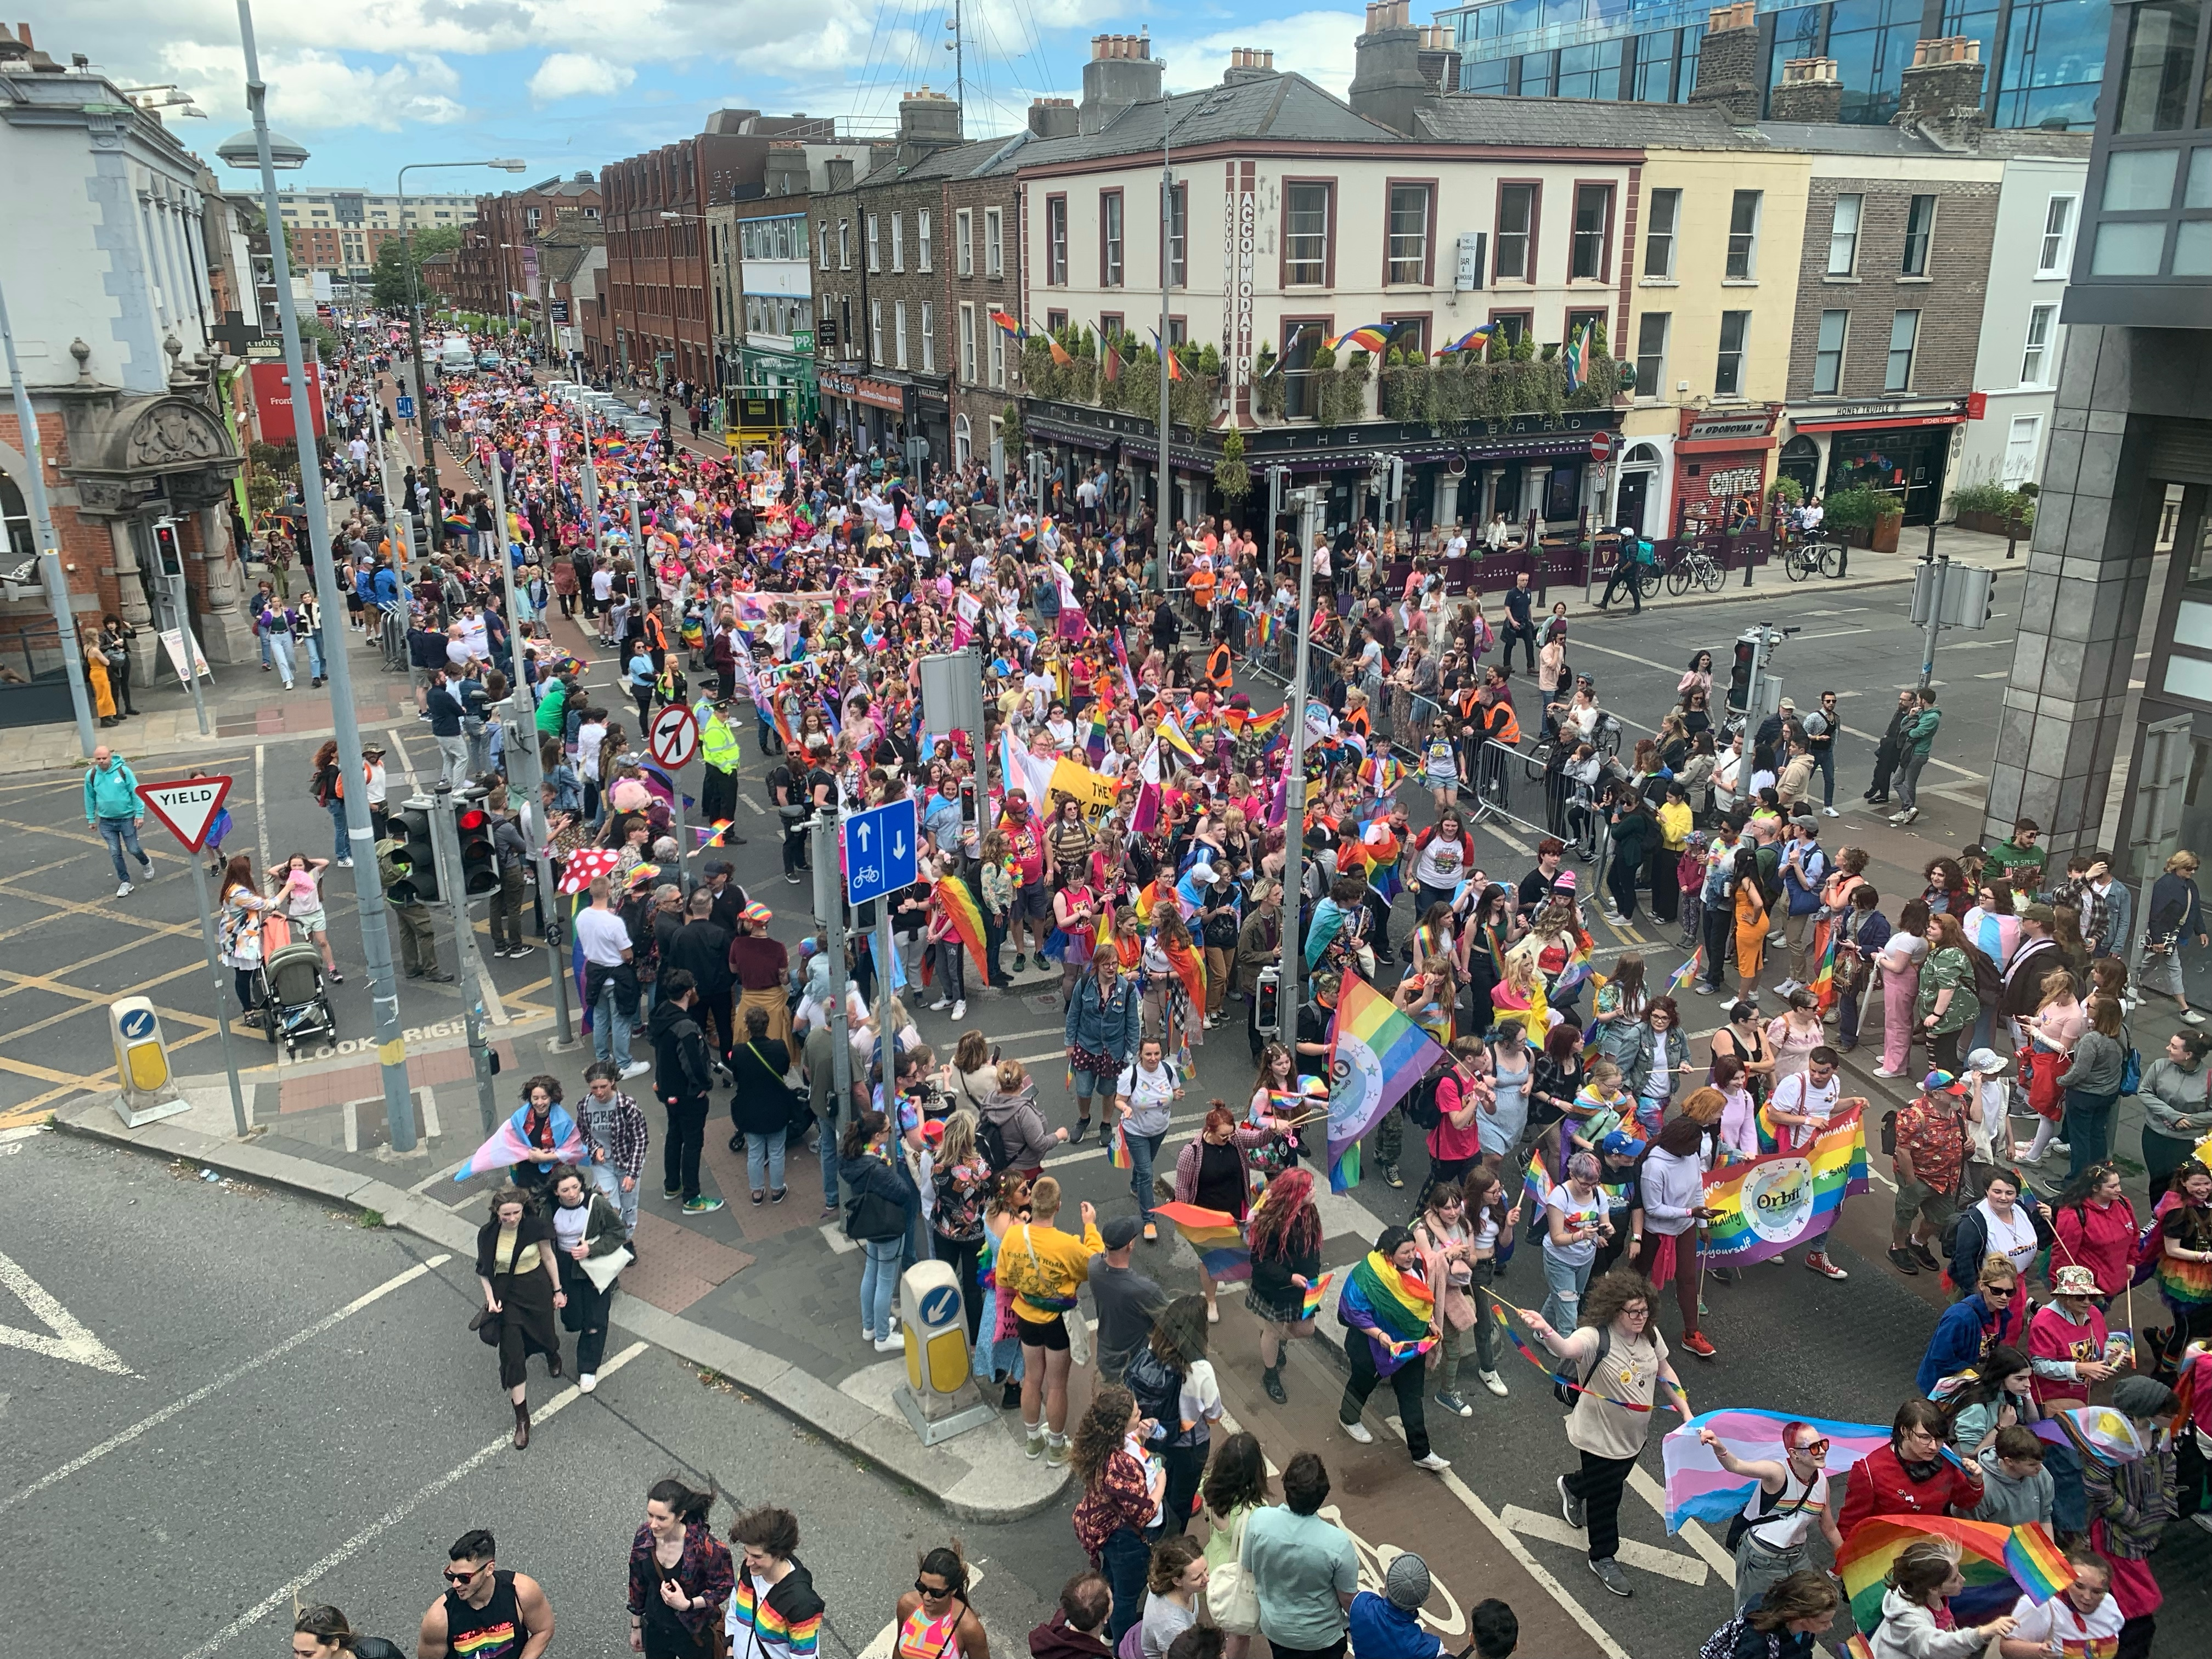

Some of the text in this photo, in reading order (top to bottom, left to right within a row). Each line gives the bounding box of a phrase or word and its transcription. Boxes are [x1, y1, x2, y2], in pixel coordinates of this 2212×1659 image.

[1238, 192, 1254, 385] ACCOMMODATION
[820, 377, 855, 394] NINJA SUSHI
[1051, 407, 1079, 421] THE
[1837, 405, 1889, 415] HONEY TRUFFLE
[1706, 424, 1753, 433] O'DONOVAN
[1286, 432, 1358, 447] THE
[1539, 445, 1582, 454] LOMBARD
[1170, 457, 1188, 466] MBARD
[160, 790, 212, 805] YIELD
[295, 1020, 467, 1063] LOOK RIGH
[1756, 1187, 1802, 1209] Orbit
